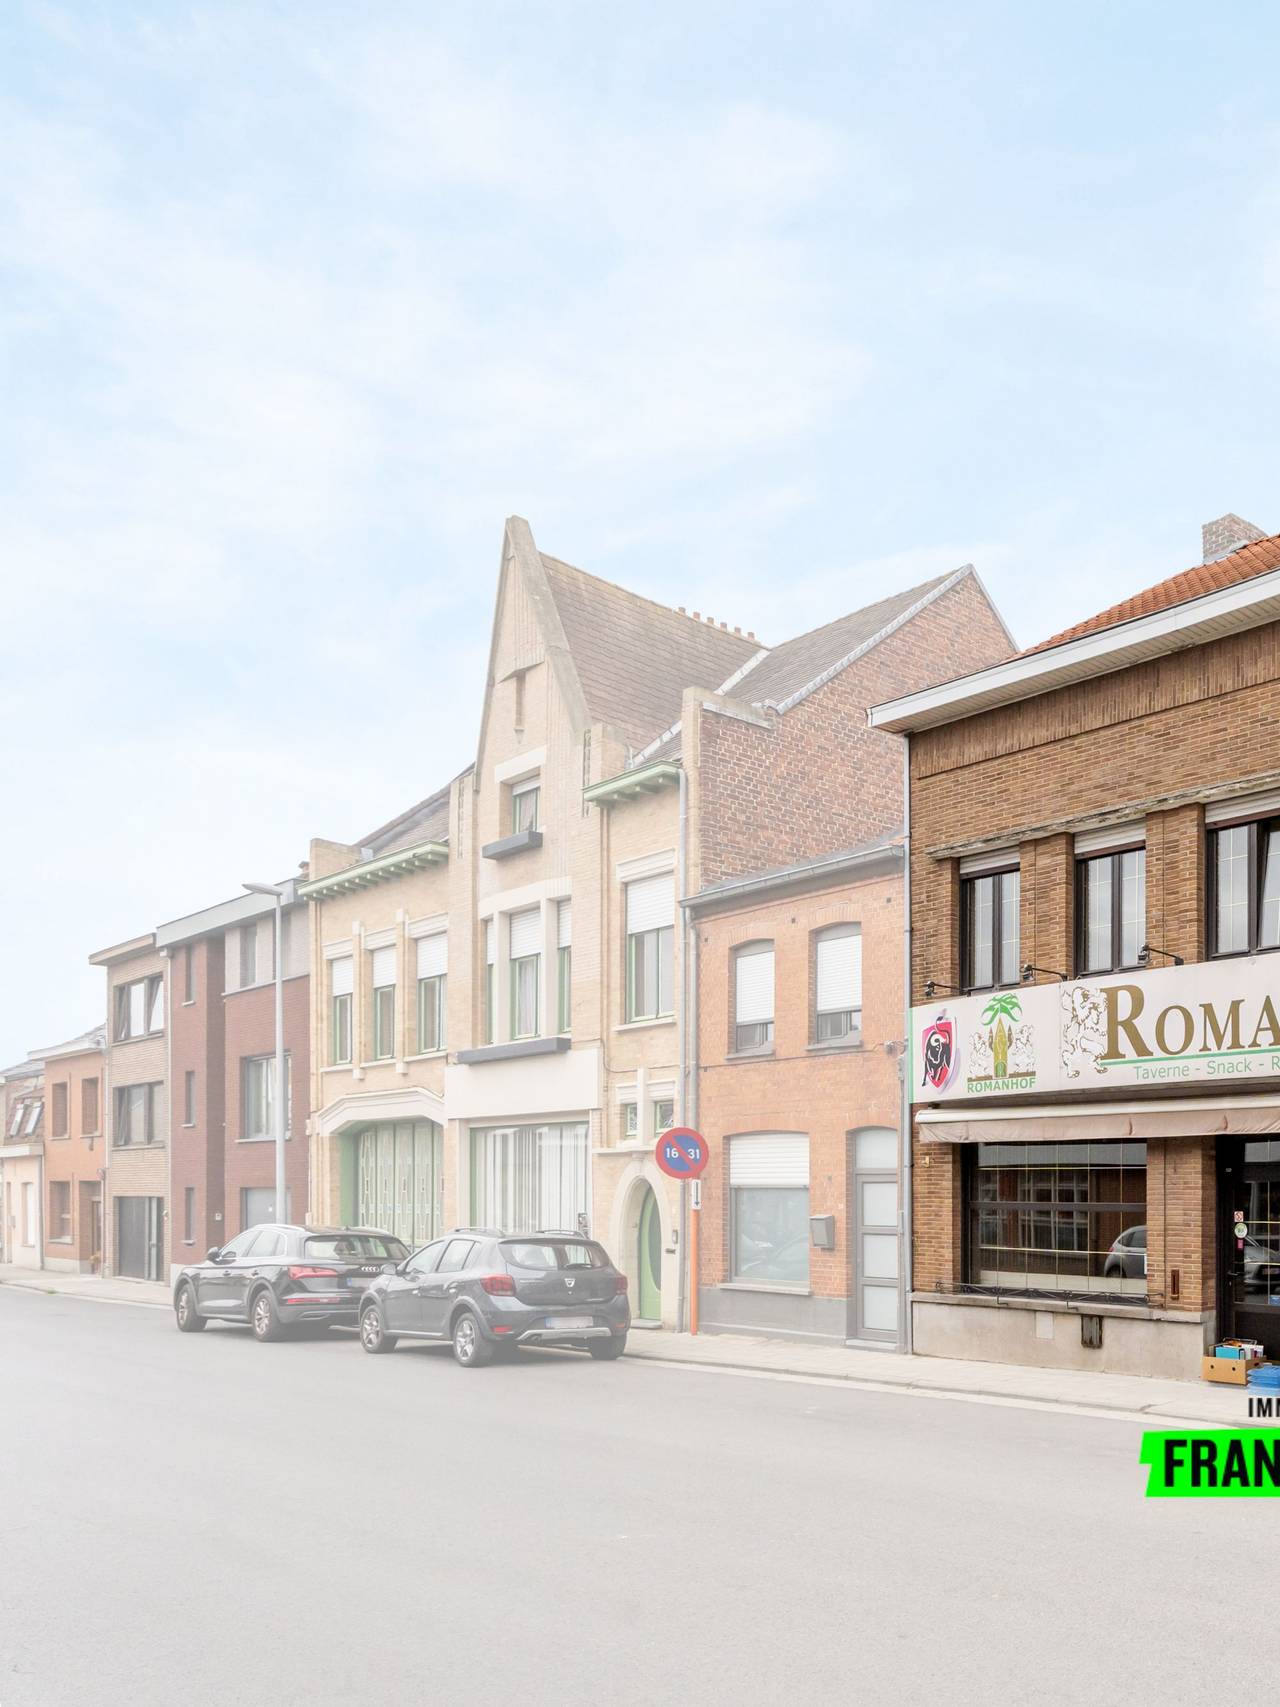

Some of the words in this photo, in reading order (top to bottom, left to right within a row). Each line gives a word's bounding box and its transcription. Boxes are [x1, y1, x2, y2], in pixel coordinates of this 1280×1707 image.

[1135, 1065, 1190, 1080] Taverne
[1207, 1056, 1252, 1075] Snack
[967, 1077, 1036, 1093] ROMANHOF
[666, 1147, 679, 1158] 16
[687, 1148, 700, 1159] 31
